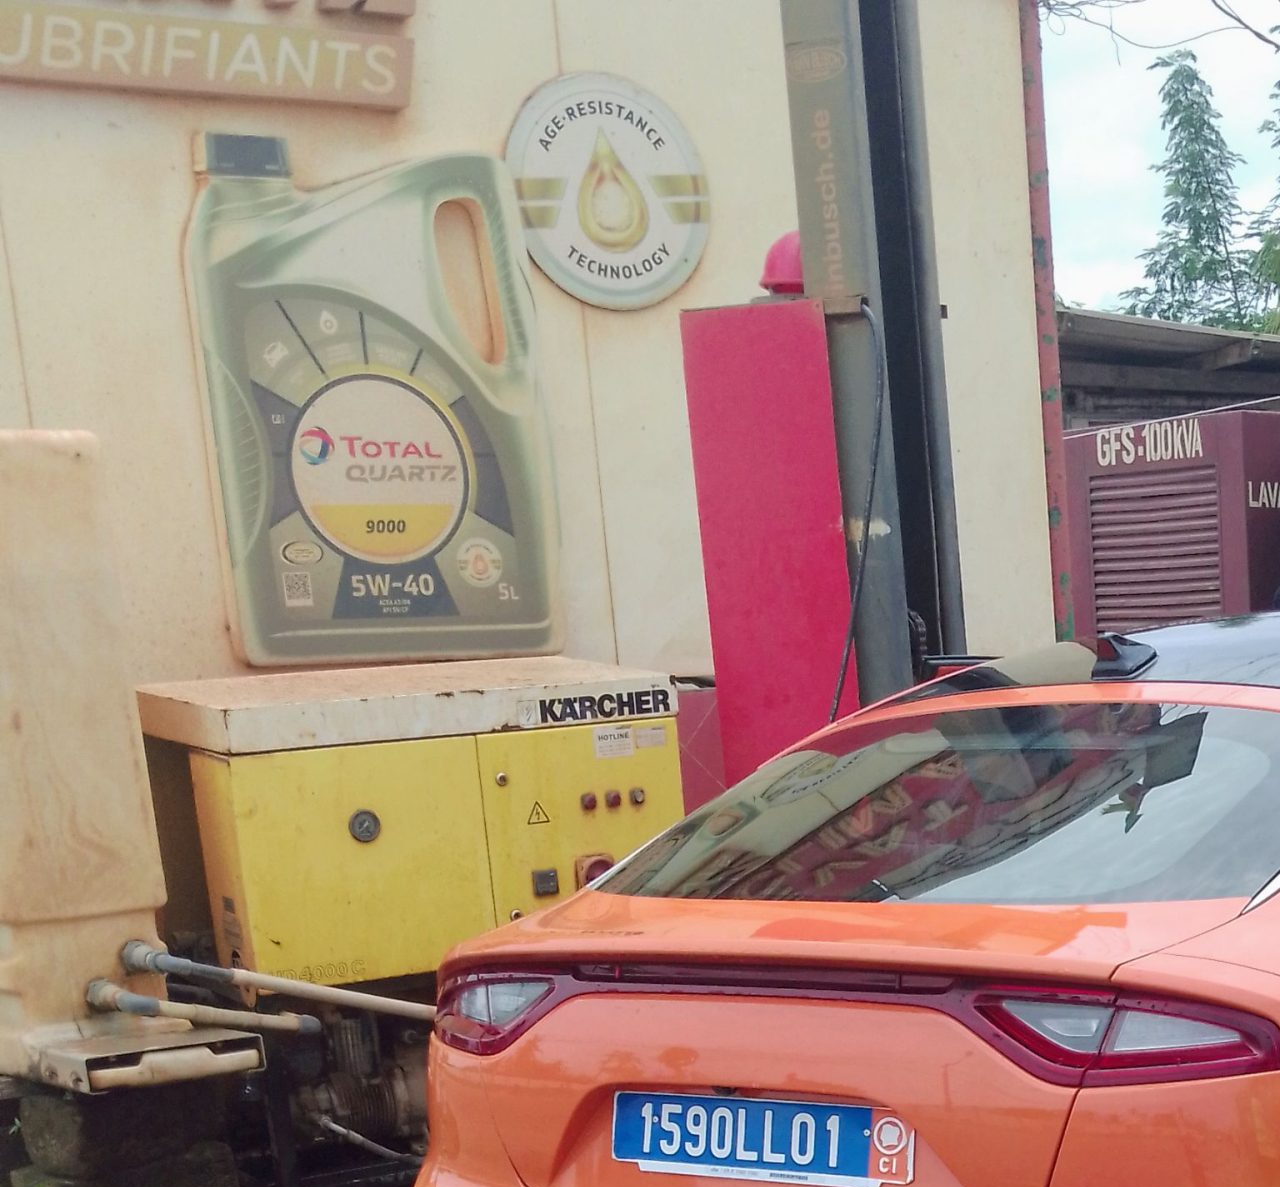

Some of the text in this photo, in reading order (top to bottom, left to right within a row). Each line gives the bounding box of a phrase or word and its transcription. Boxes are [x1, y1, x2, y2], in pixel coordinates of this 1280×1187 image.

[567, 243, 670, 280] TECHNOLOGY
[340, 436, 443, 458] TOTAL
[345, 465, 457, 484] QUARTZ
[366, 519, 406, 534] 9000
[351, 573, 435, 597] 5W-40
[539, 689, 671, 723] KÄRCHER
[598, 731, 630, 741] HOTLINE
[641, 1102, 840, 1168] 1590LL01
[878, 1157, 897, 1174] CI
